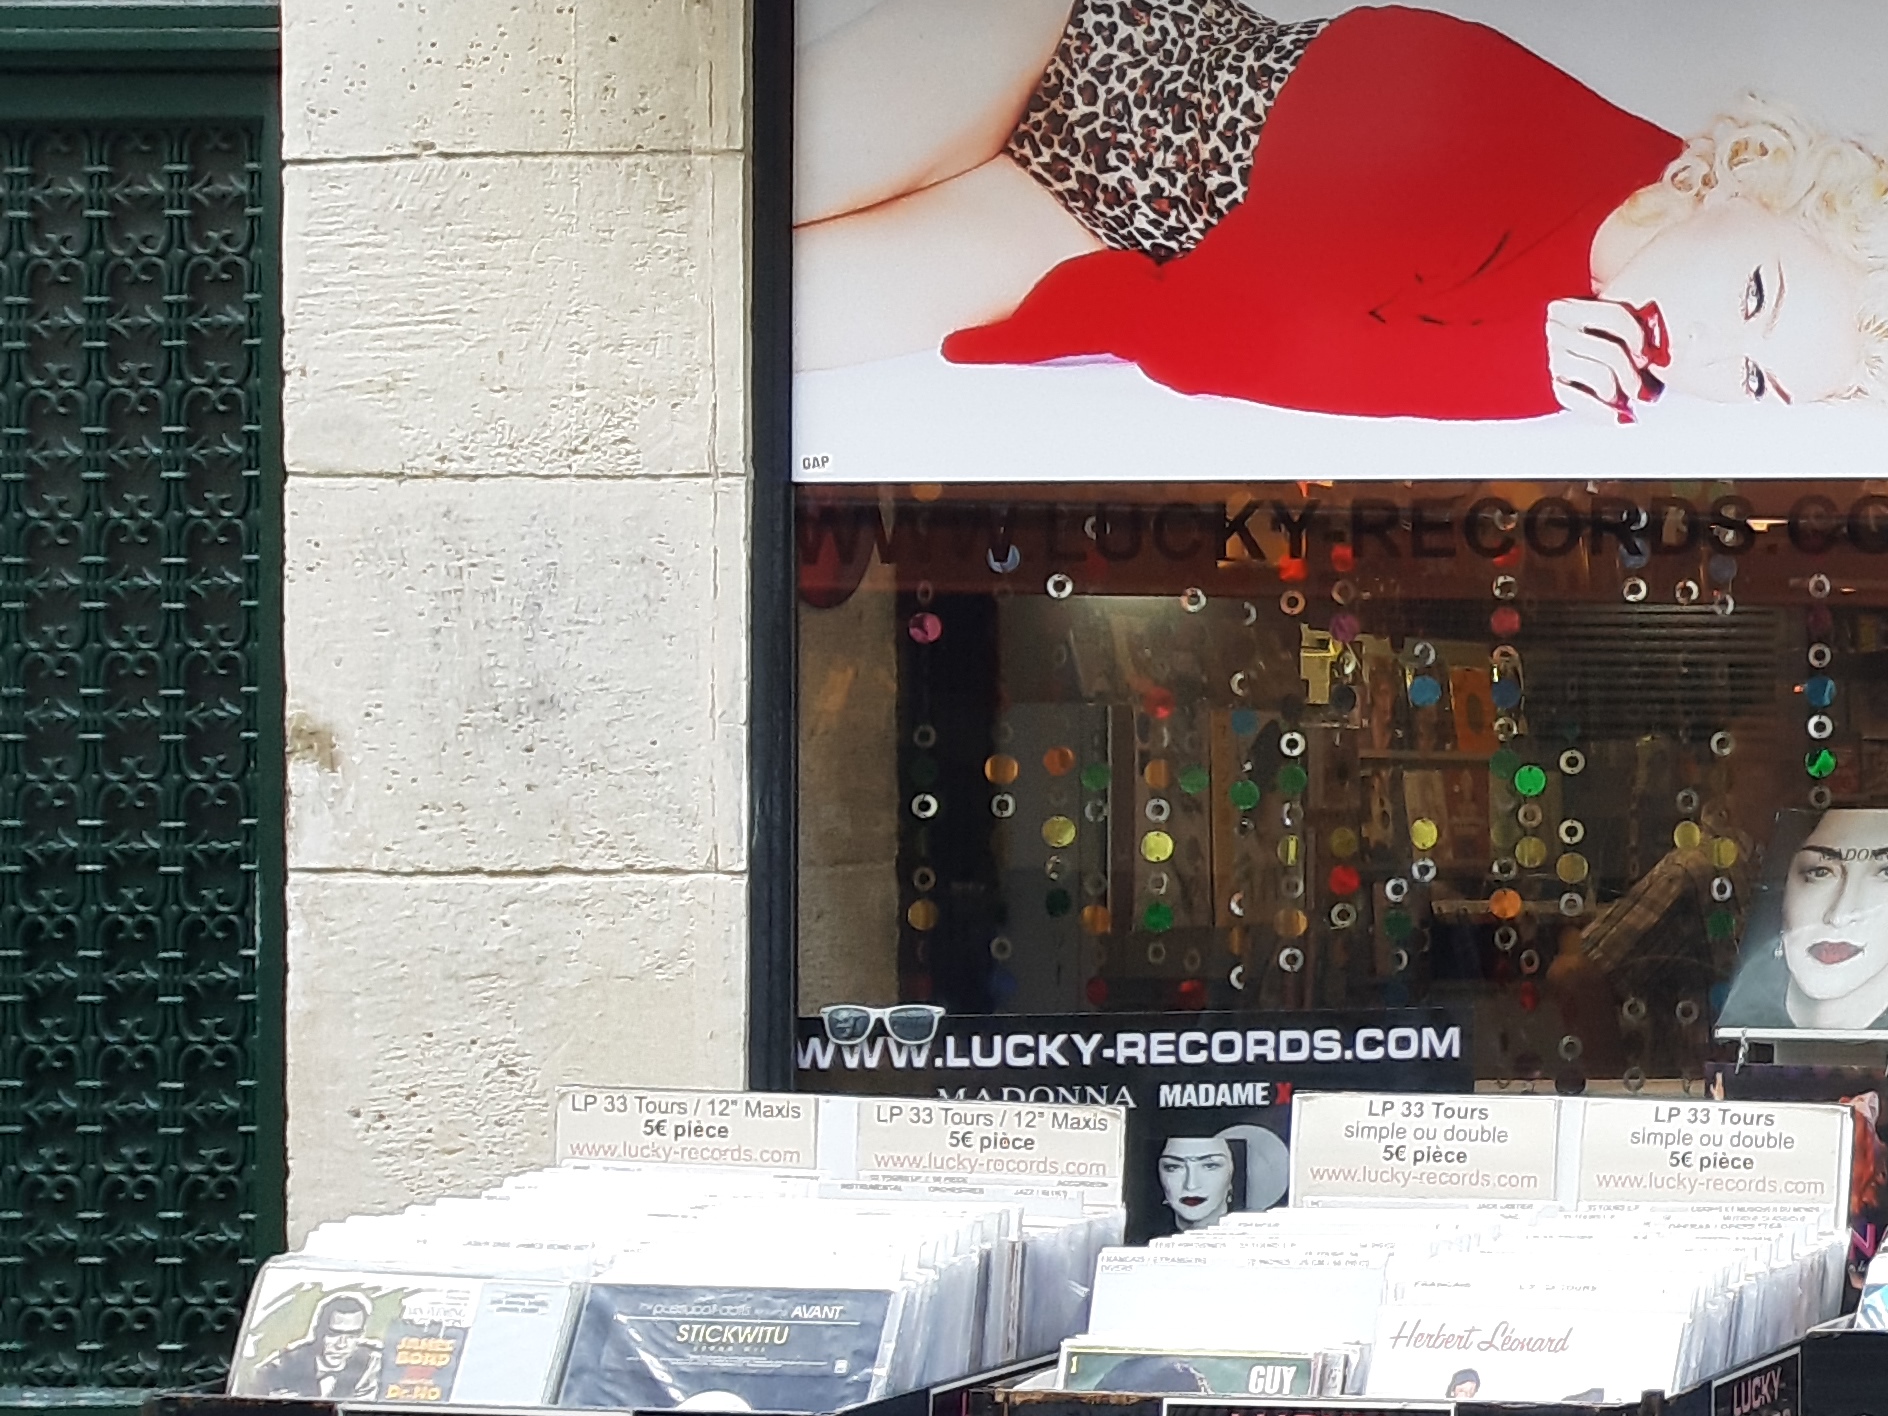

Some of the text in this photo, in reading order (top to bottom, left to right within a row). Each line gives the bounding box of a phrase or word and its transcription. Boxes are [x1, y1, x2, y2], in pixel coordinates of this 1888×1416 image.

[797, 1027, 1461, 1070] WWW.LUCKY-RECORDS.COM
[1158, 1082, 1269, 1108] MADAME
[1274, 1080, 1290, 1106] X
[572, 1094, 597, 1113] LP
[602, 1094, 628, 1113] 33
[635, 1096, 687, 1115] Tours
[745, 1100, 801, 1120] Maxis
[1368, 1100, 1488, 1120] LP 33 Tours
[643, 1120, 729, 1141] 5€ pièce
[1345, 1122, 1509, 1144] simple ou double
[570, 1140, 800, 1165] www.lucky-records.com
[1383, 1145, 1467, 1166] 5€ pièce
[1310, 1165, 1538, 1190] www.lucky-records.com
[791, 1304, 846, 1320] AVANT
[676, 1324, 788, 1346] STICKWITU
[1390, 1320, 1477, 1353] Herbert
[1248, 1364, 1297, 1395] GUY
